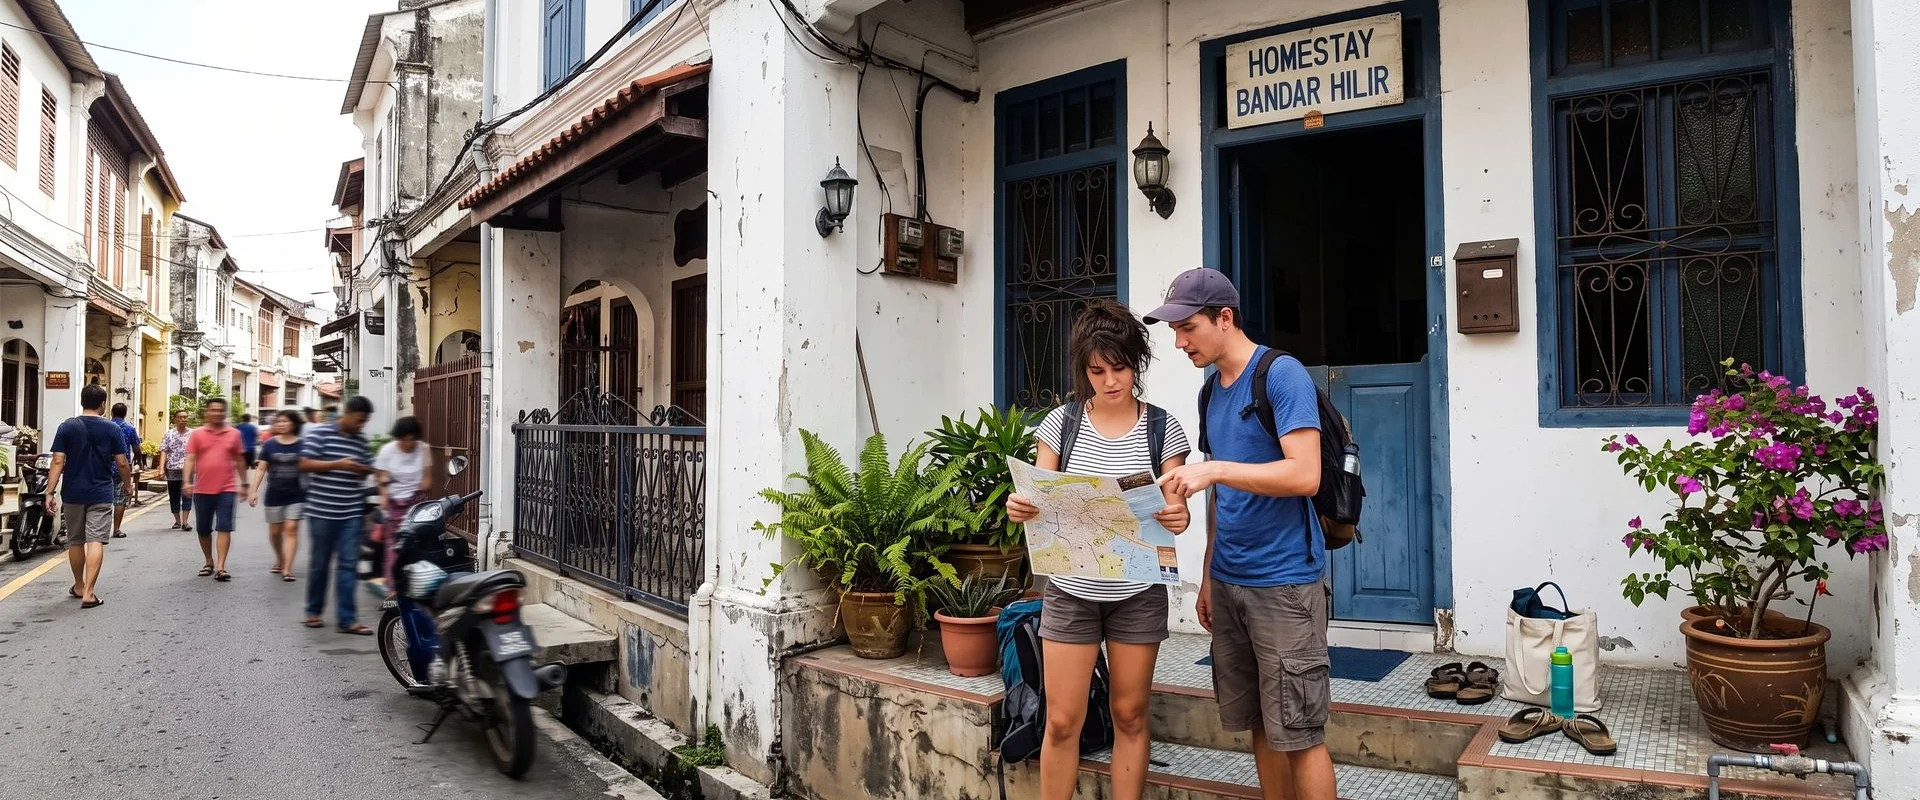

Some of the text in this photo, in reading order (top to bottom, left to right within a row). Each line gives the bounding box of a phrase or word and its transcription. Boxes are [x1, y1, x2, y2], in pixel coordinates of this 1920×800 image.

[1249, 28, 1374, 78] HOMESTAY
[1237, 65, 1389, 117] BANDAR HILIR
